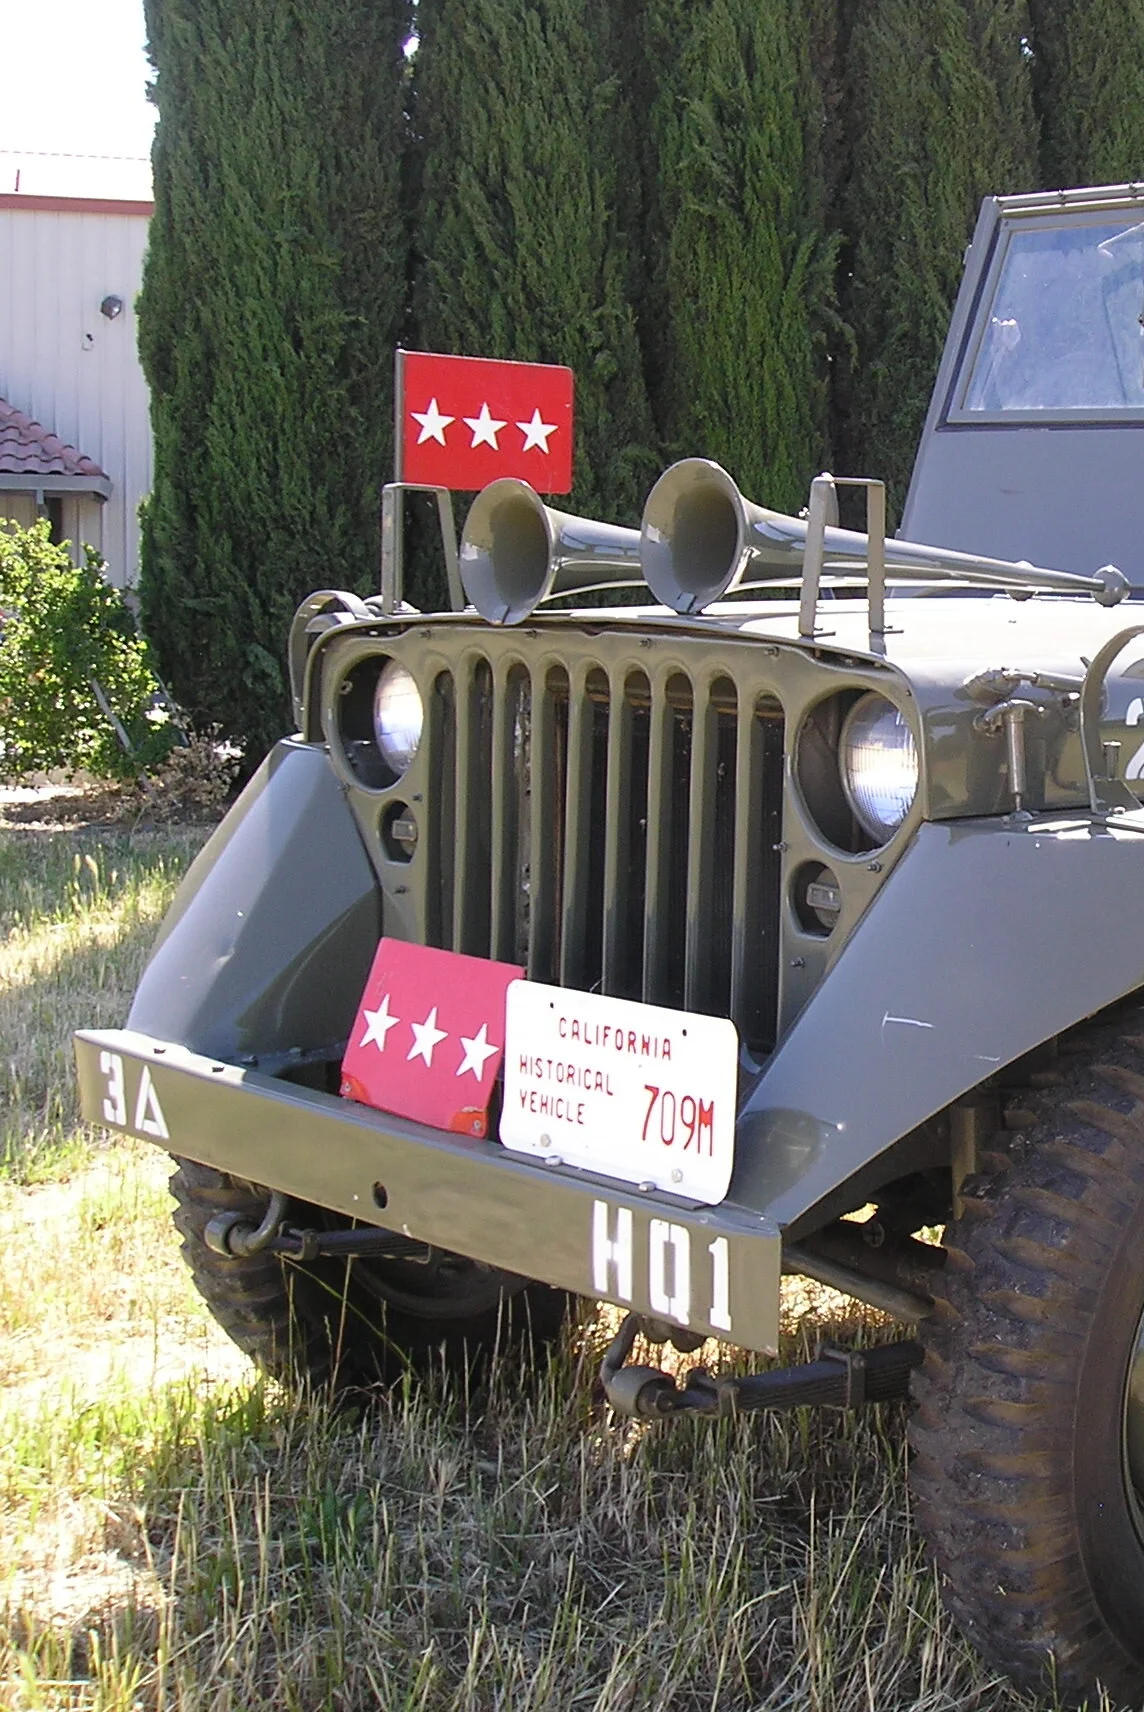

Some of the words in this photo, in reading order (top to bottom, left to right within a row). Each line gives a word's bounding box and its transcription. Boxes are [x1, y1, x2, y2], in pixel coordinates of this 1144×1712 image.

[559, 1017, 672, 1060] CALIFORNIA
[520, 1054, 614, 1096] HISTORICAL
[520, 1091, 586, 1125] VEHICLE
[642, 1085, 715, 1157] 709M
